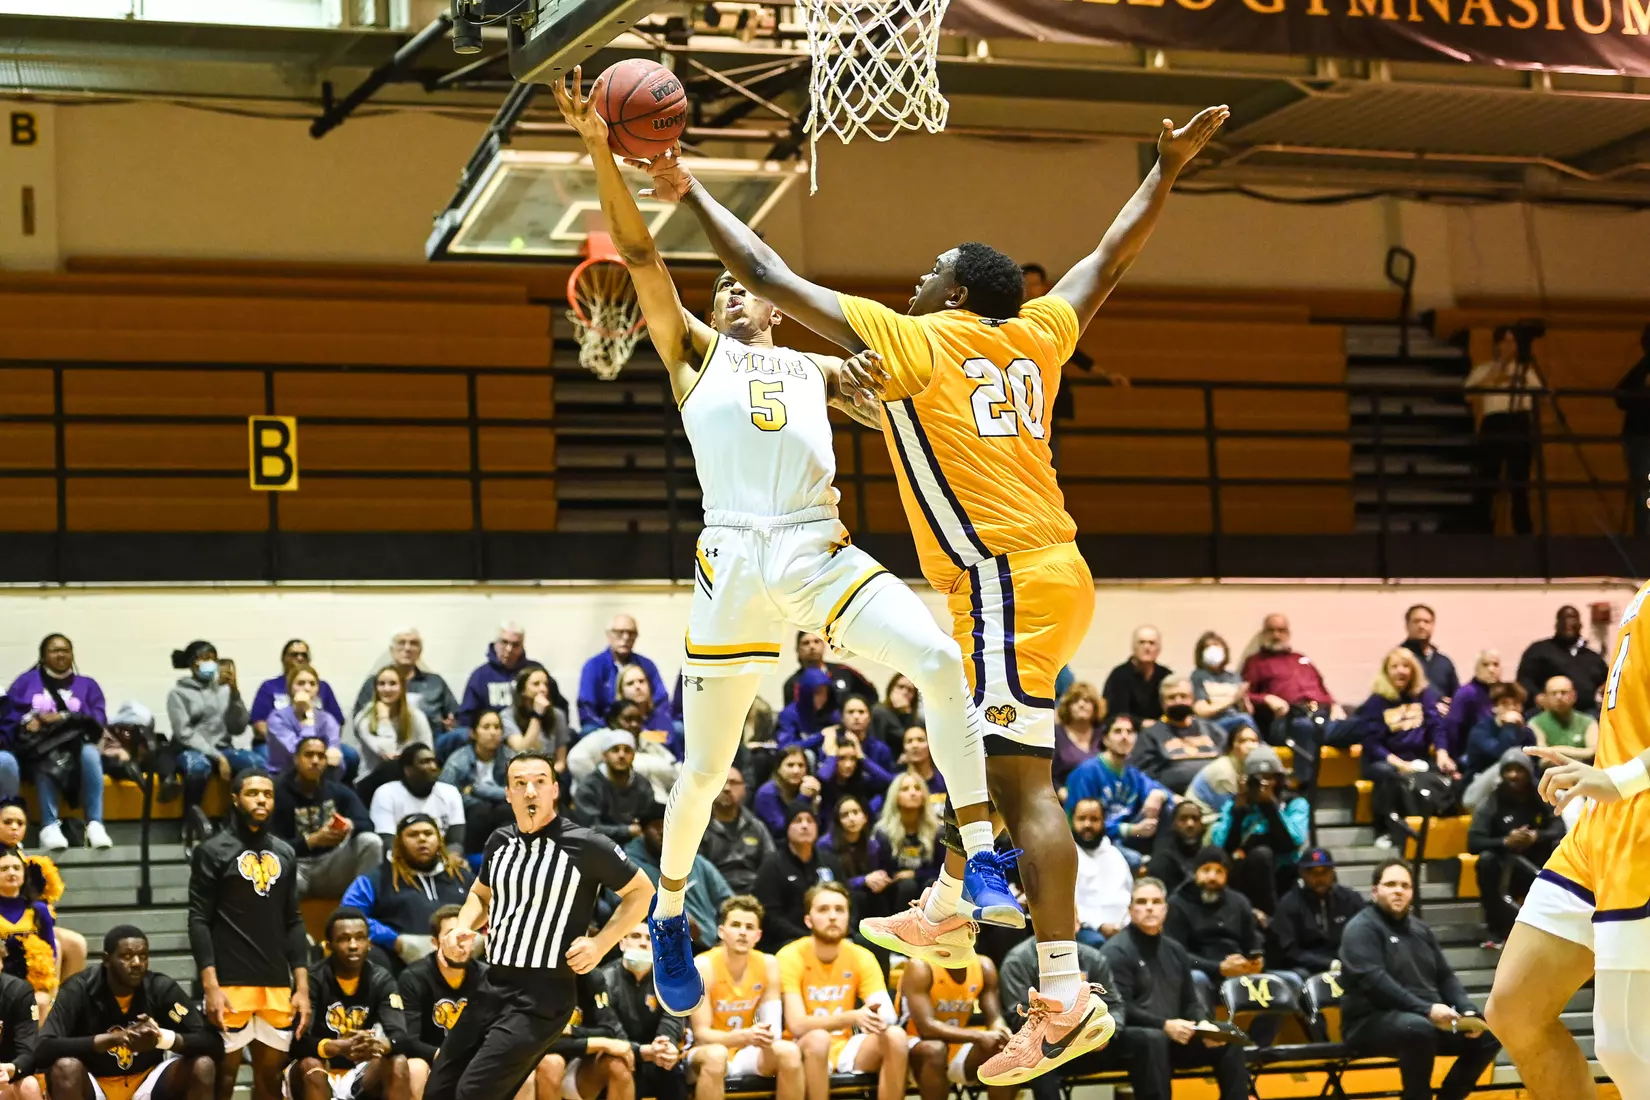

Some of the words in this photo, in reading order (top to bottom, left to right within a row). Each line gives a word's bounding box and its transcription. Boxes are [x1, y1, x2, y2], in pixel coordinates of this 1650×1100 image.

[1236, 0, 1650, 35] NASIU
[10, 111, 38, 146] B
[748, 379, 788, 432] 5
[961, 357, 1045, 440] 20
[253, 419, 294, 486] B
